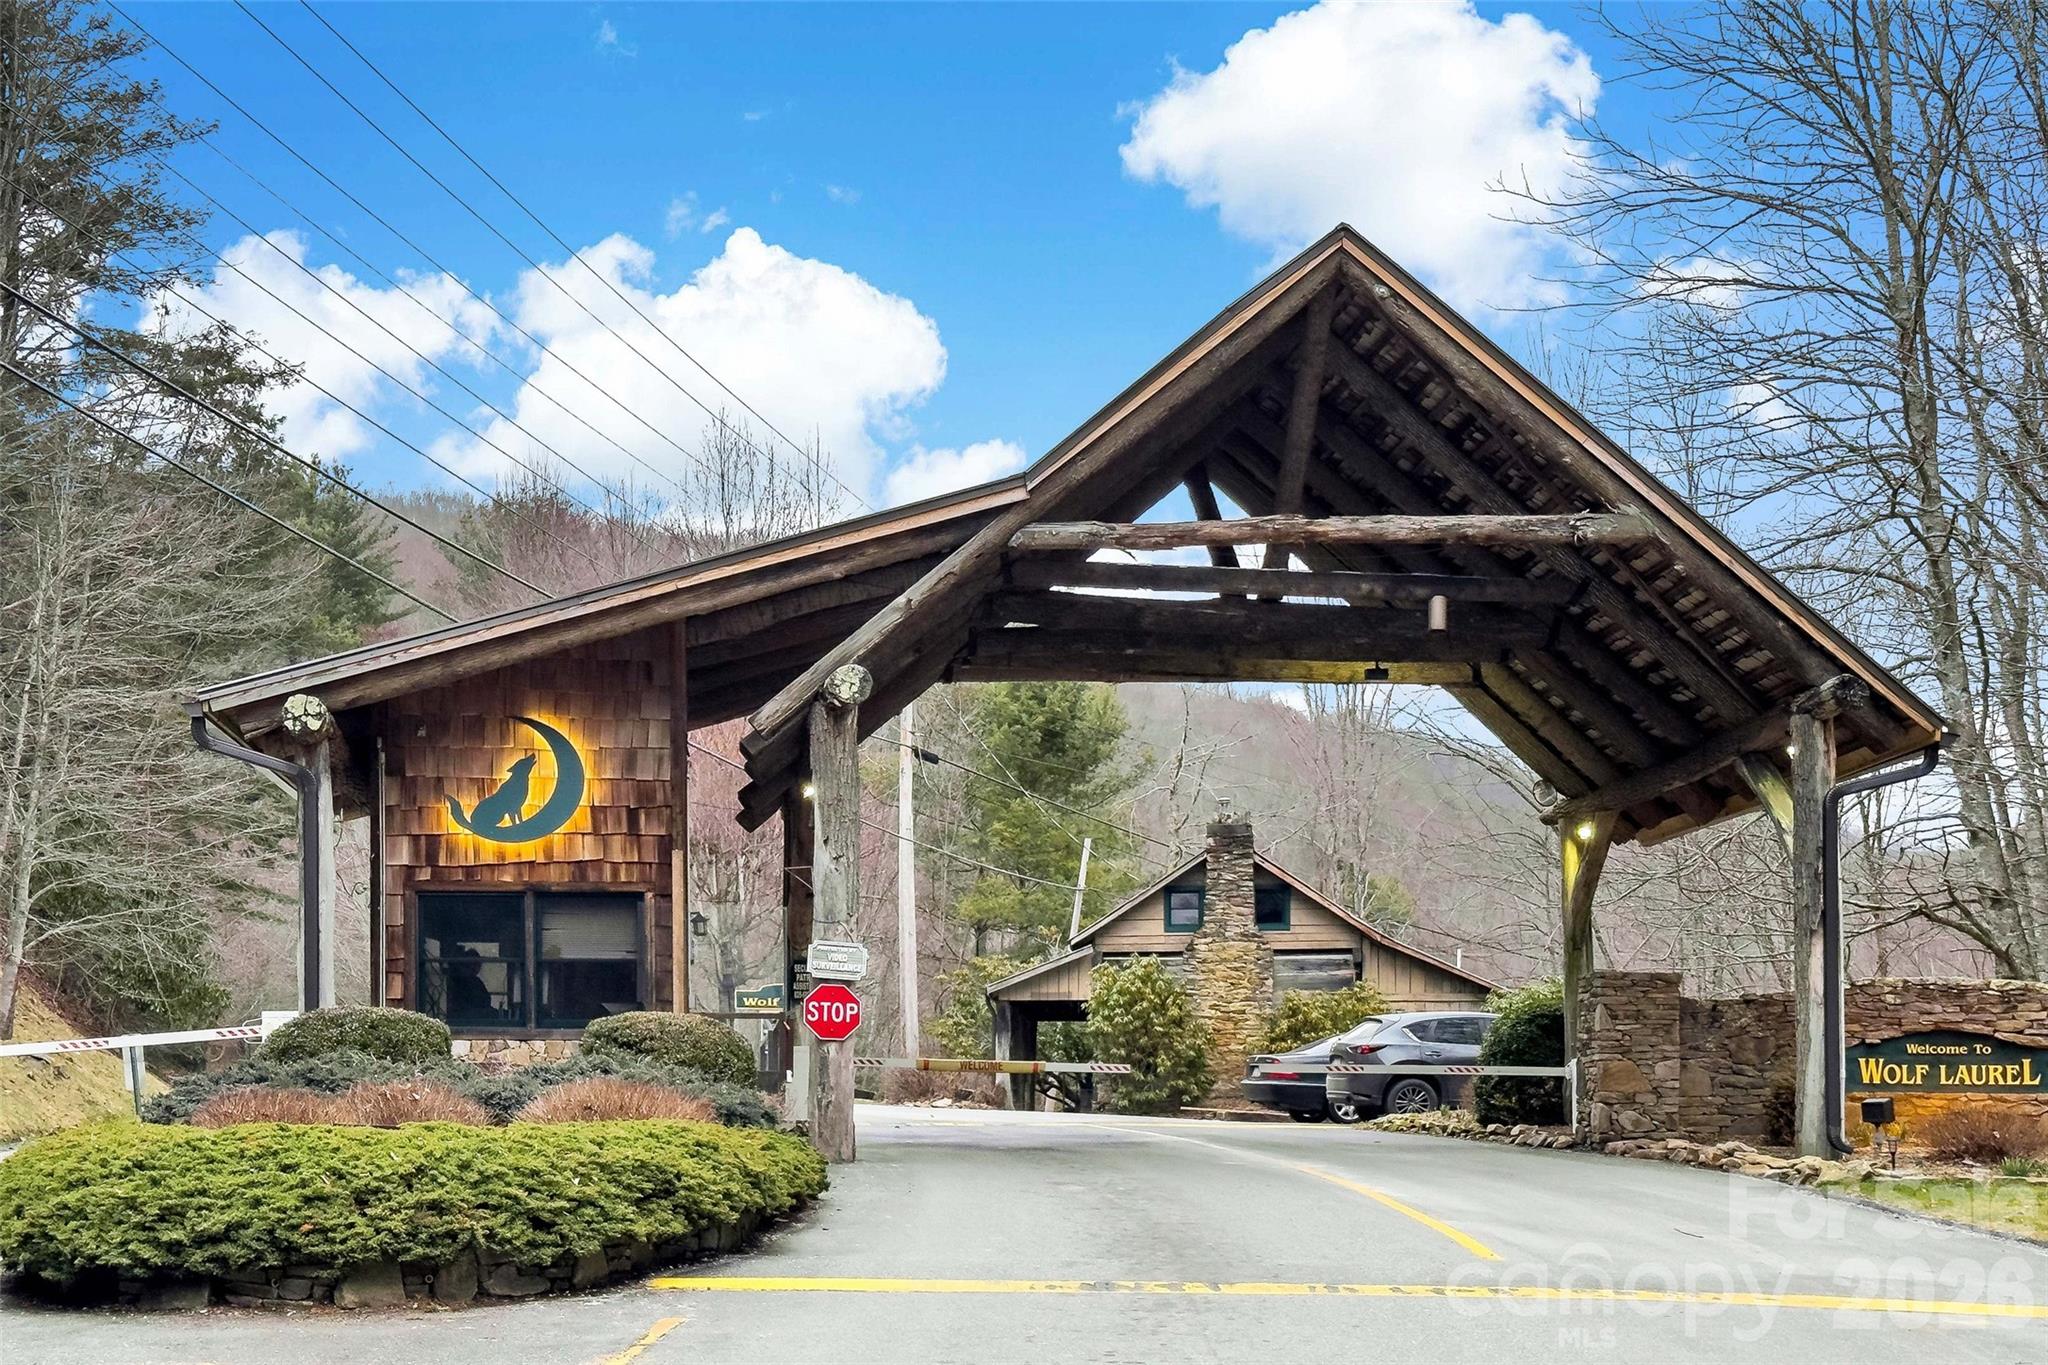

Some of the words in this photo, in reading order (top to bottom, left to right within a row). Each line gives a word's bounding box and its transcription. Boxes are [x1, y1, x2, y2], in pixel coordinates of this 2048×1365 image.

[827, 952, 848, 962] VIDEO
[742, 997, 780, 1007] Wolf
[807, 1001, 858, 1023] STOP
[1906, 1043, 1968, 1055] Welcome
[1973, 1043, 1992, 1055] To
[959, 1060, 1004, 1072] WELCOME
[1858, 1057, 1930, 1085] WOLF
[1939, 1058, 2042, 1086] LAUREL
